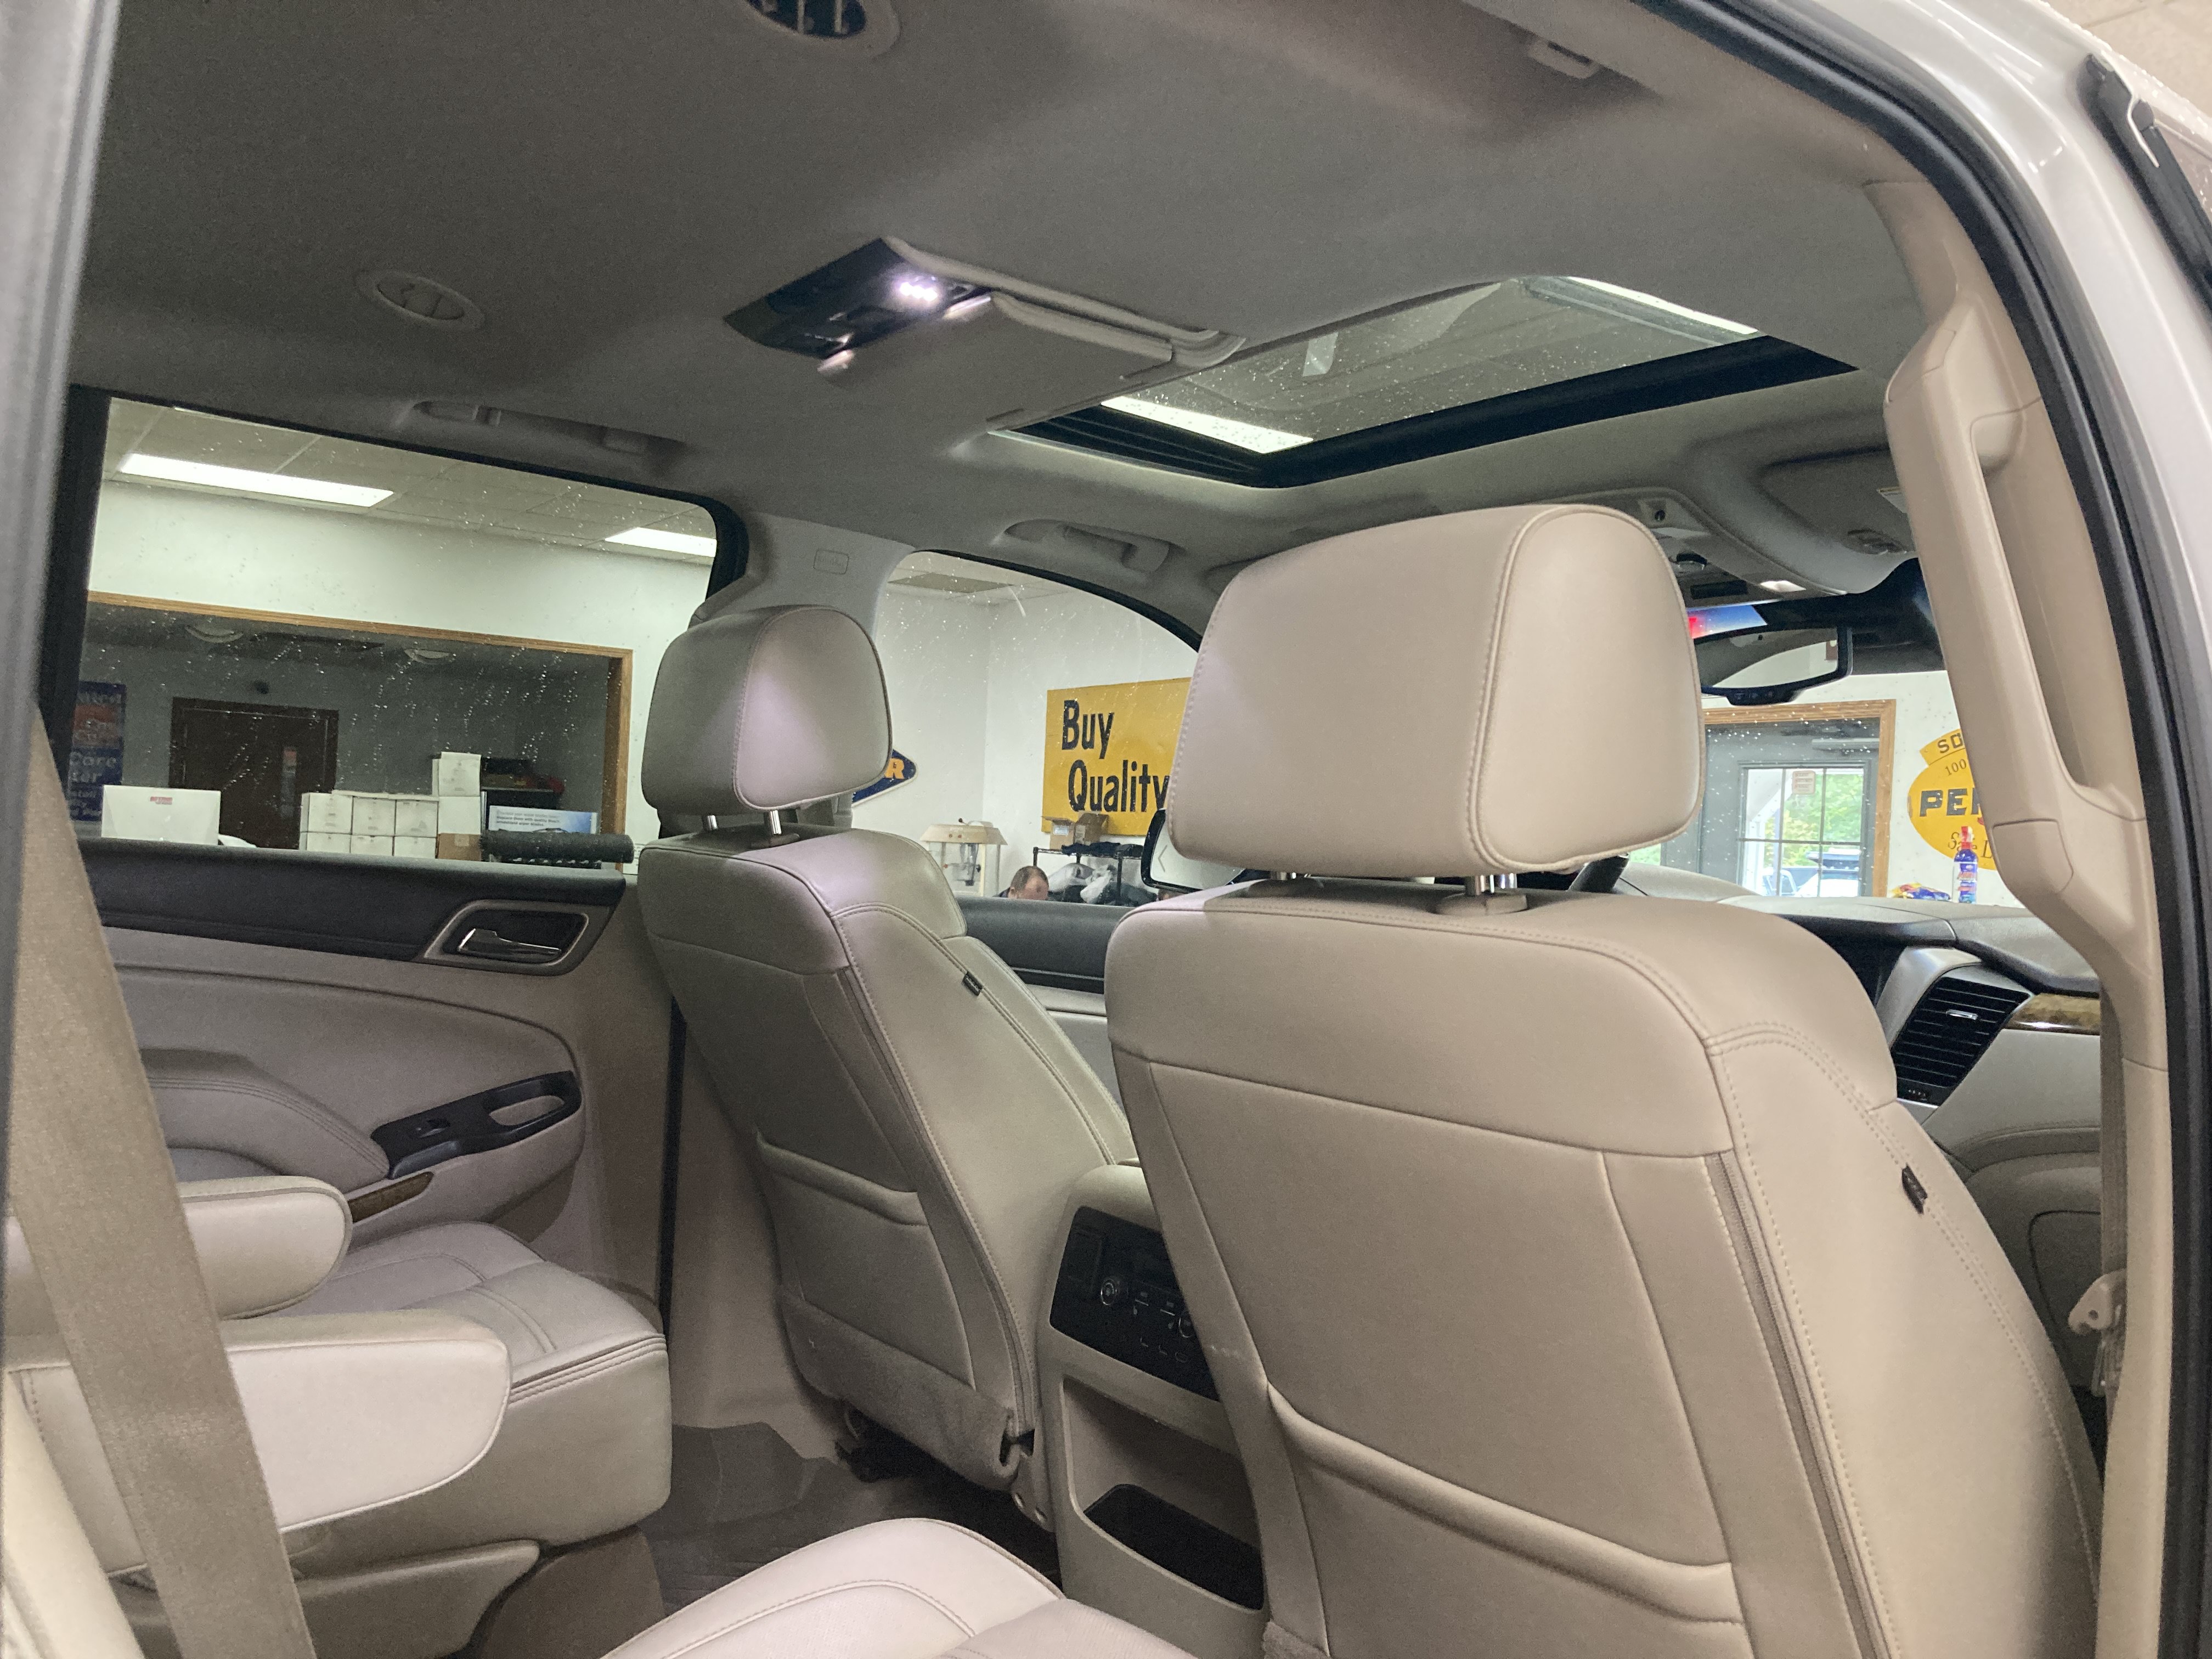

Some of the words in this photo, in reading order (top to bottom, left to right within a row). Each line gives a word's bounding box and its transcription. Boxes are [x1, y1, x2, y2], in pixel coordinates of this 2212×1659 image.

[1062, 699, 1114, 759] Buy
[1068, 759, 1170, 812] Quality
[1945, 759, 1967, 776] 100
